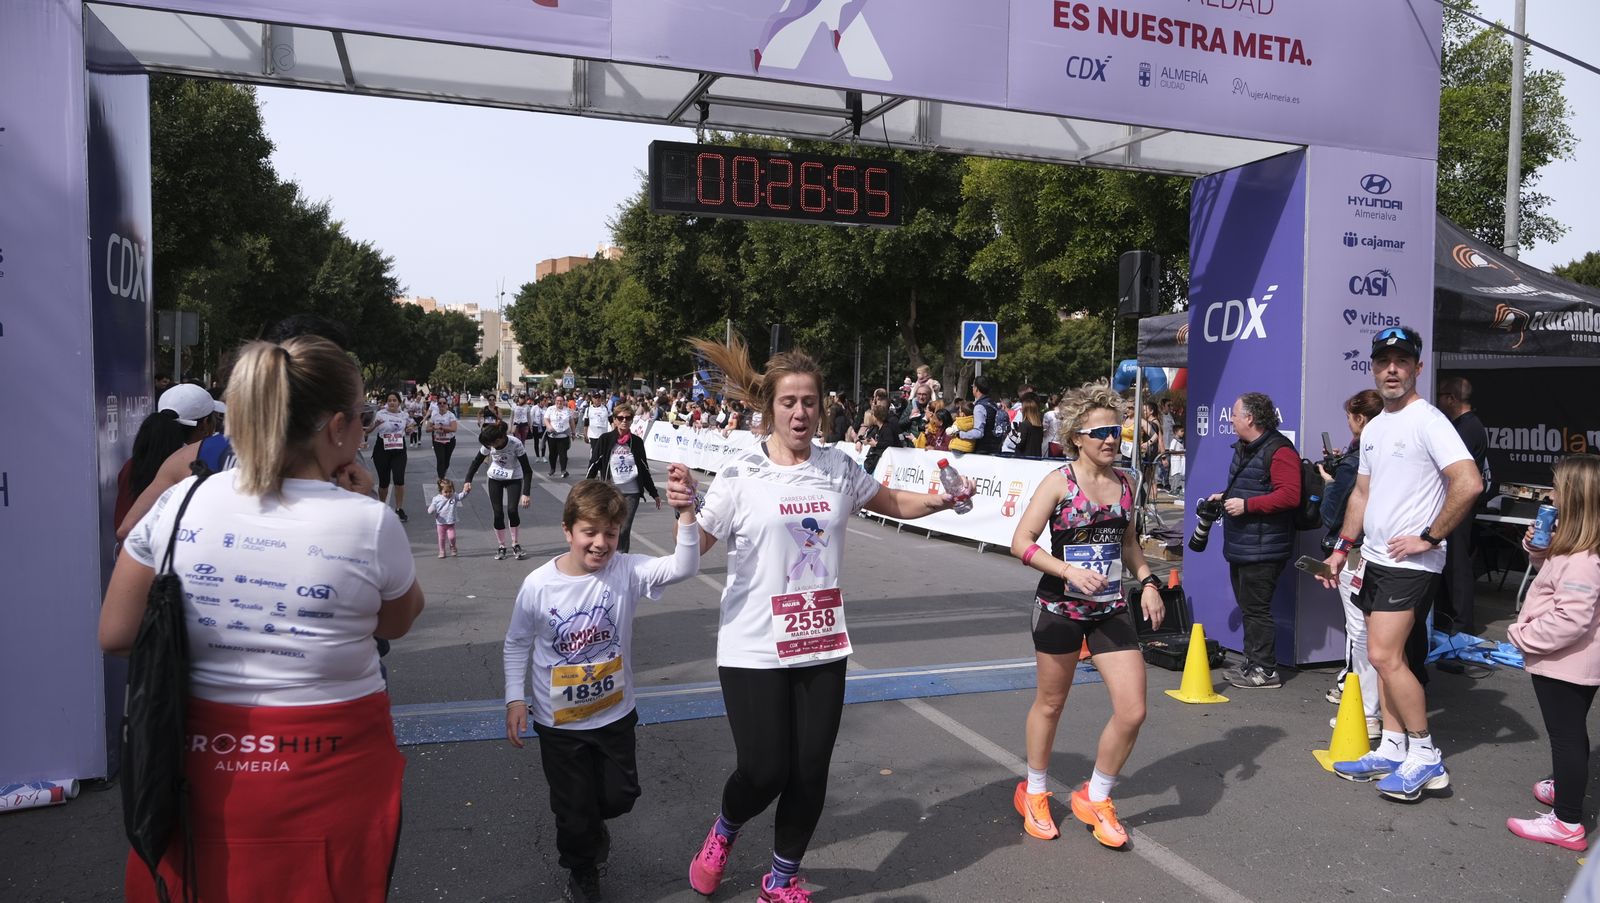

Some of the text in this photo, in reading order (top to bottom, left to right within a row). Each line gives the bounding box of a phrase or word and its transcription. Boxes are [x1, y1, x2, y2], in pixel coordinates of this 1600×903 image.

[1053, 0, 1313, 66] ES NUESTRA META.
[1066, 56, 1112, 82] CDX
[1160, 66, 1208, 85] ALMERÍA
[1160, 79, 1186, 91] CIUDAD
[697, 152, 890, 218] 00:26:55
[1347, 195, 1403, 210] HYUNDAI
[1361, 235, 1406, 250] cajamar
[107, 233, 146, 302] CDX
[1348, 275, 1388, 297] CASI
[1203, 286, 1278, 343] CDX
[1360, 311, 1400, 327] vithas
[780, 495, 808, 503] CARRERA
[779, 501, 831, 515] MUJER
[176, 528, 203, 543] DX
[243, 536, 287, 549] ALMERÍA
[249, 577, 288, 588] cajamar
[296, 584, 331, 600] CASI
[783, 608, 836, 633] 2558
[562, 675, 615, 702] 1836
[187, 733, 343, 755] ROSSHIIT
[214, 758, 290, 772] ALMERÍA
